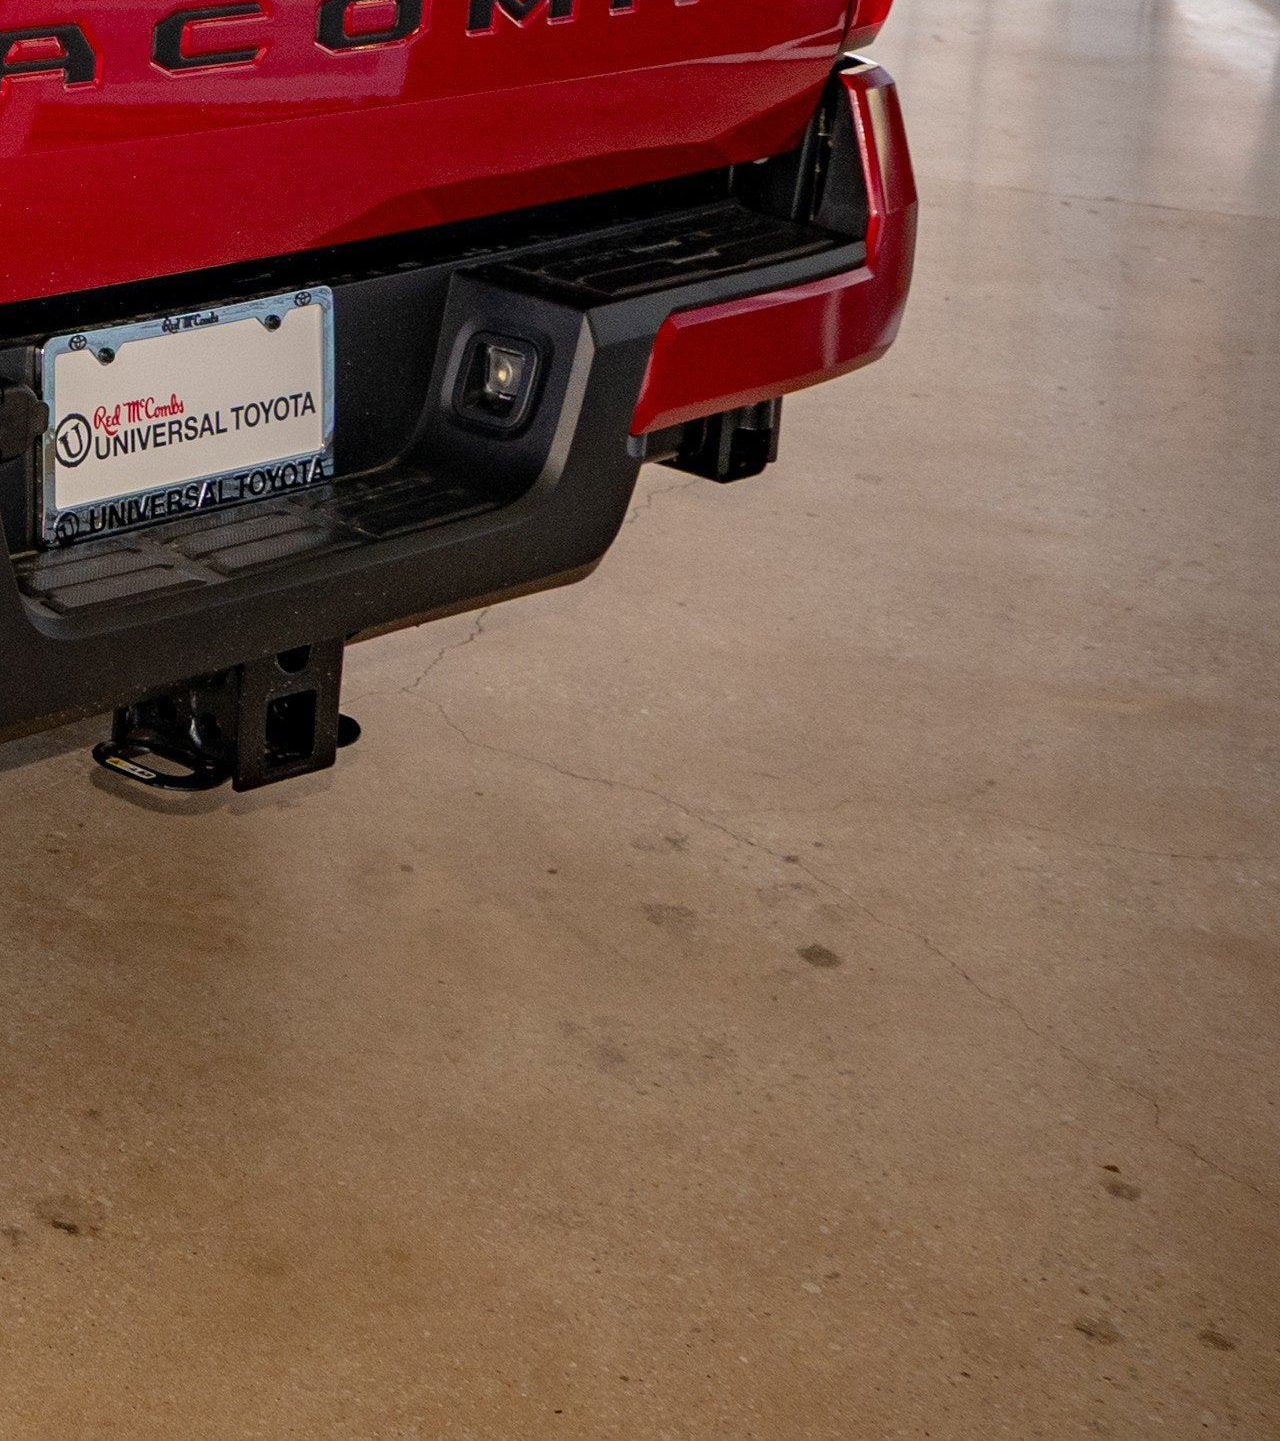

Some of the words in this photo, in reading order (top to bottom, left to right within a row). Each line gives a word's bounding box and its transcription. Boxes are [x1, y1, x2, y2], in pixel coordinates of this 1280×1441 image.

[93, 405, 121, 436] Red
[123, 394, 185, 423] McCombs
[95, 411, 228, 460] UNIVERSAL
[231, 391, 317, 431] TOYOTA
[90, 481, 233, 534] UNIVERSAL
[234, 457, 327, 499] TOYOTA
